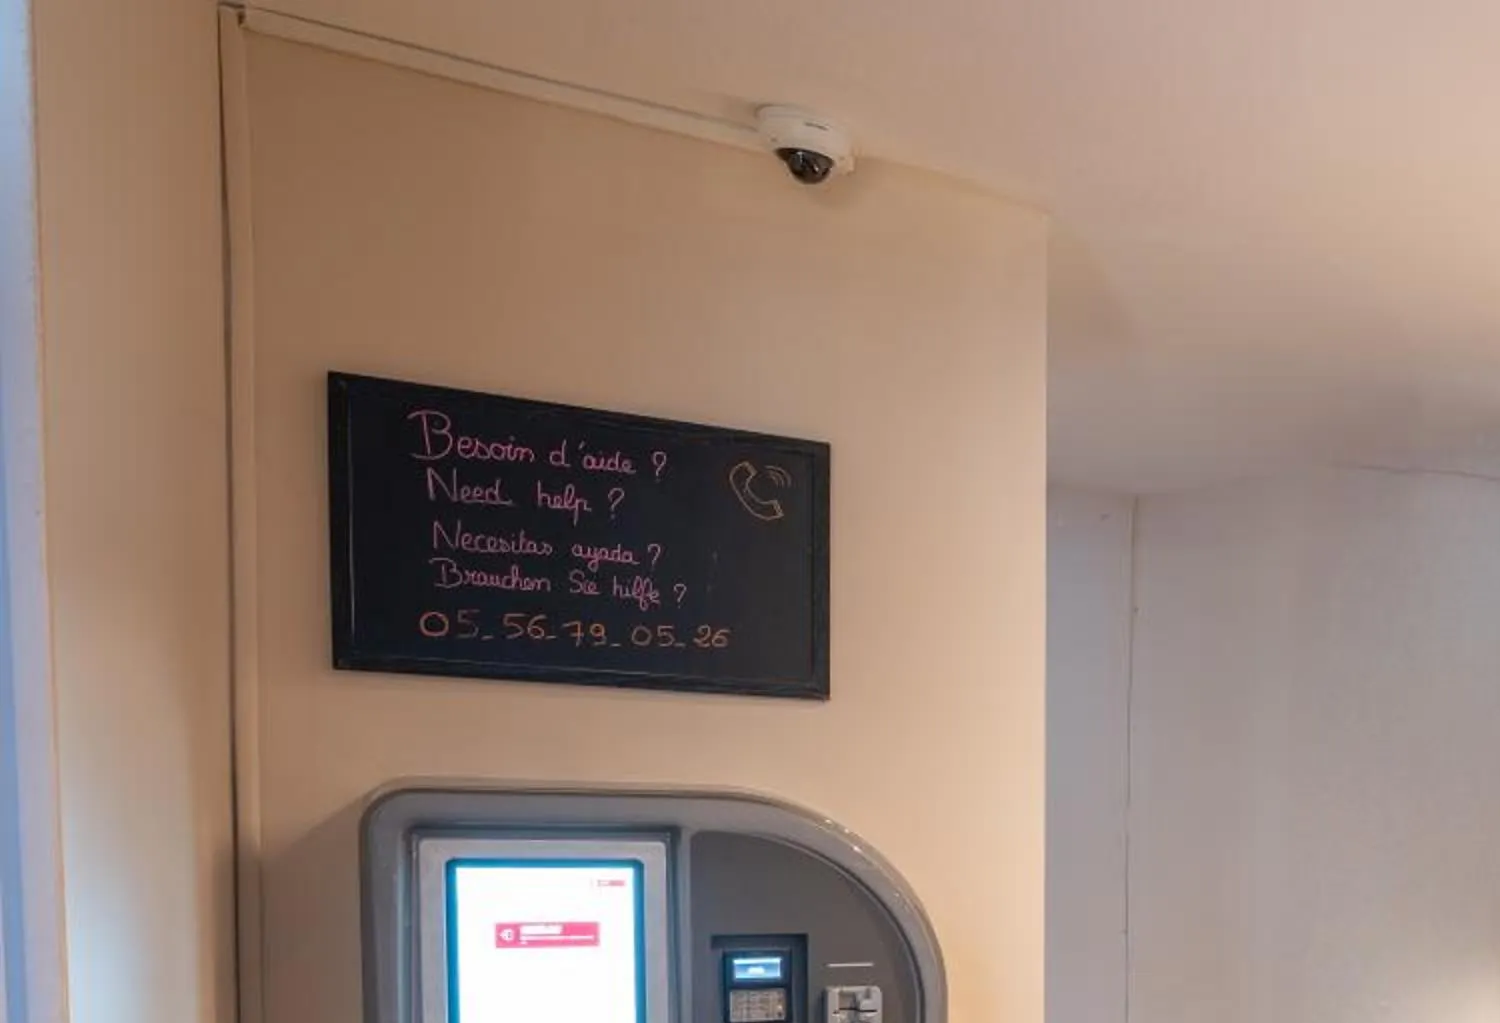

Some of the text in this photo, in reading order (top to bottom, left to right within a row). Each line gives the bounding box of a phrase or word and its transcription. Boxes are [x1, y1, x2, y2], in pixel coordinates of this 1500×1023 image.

[407, 410, 536, 463] Besoin
[652, 451, 668, 483] ?
[426, 467, 625, 526] Need help ?
[432, 520, 553, 555] Necesitas
[648, 543, 662, 572] ?
[428, 557, 550, 593] Brauchen
[569, 569, 601, 595] Sie
[673, 583, 687, 609] ?
